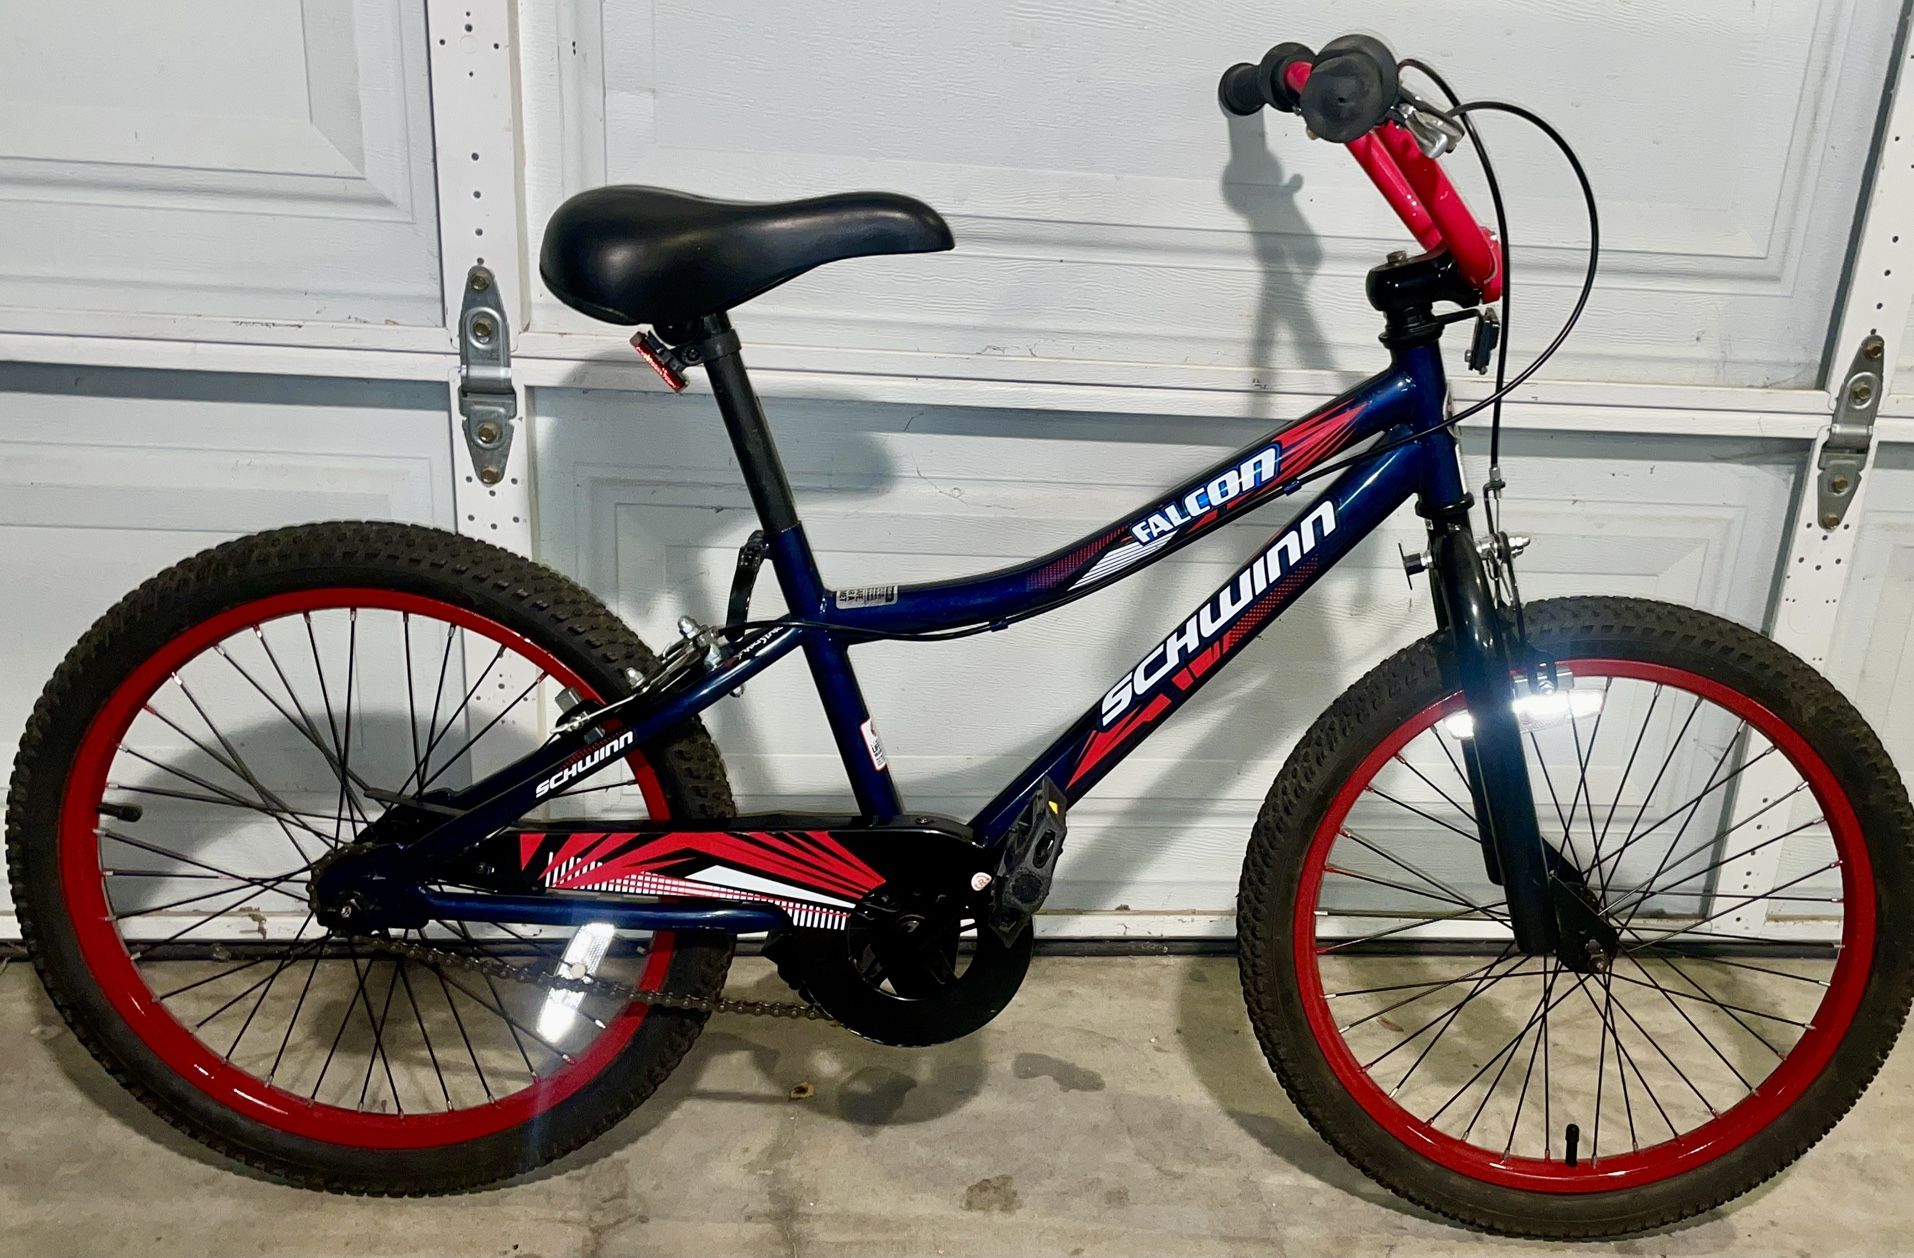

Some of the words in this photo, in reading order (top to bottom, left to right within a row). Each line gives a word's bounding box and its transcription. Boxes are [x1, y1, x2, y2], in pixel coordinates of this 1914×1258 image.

[1131, 447, 1277, 544] FALCON
[1101, 500, 1337, 727] SCHWINN
[535, 730, 634, 798] SCHWINN
